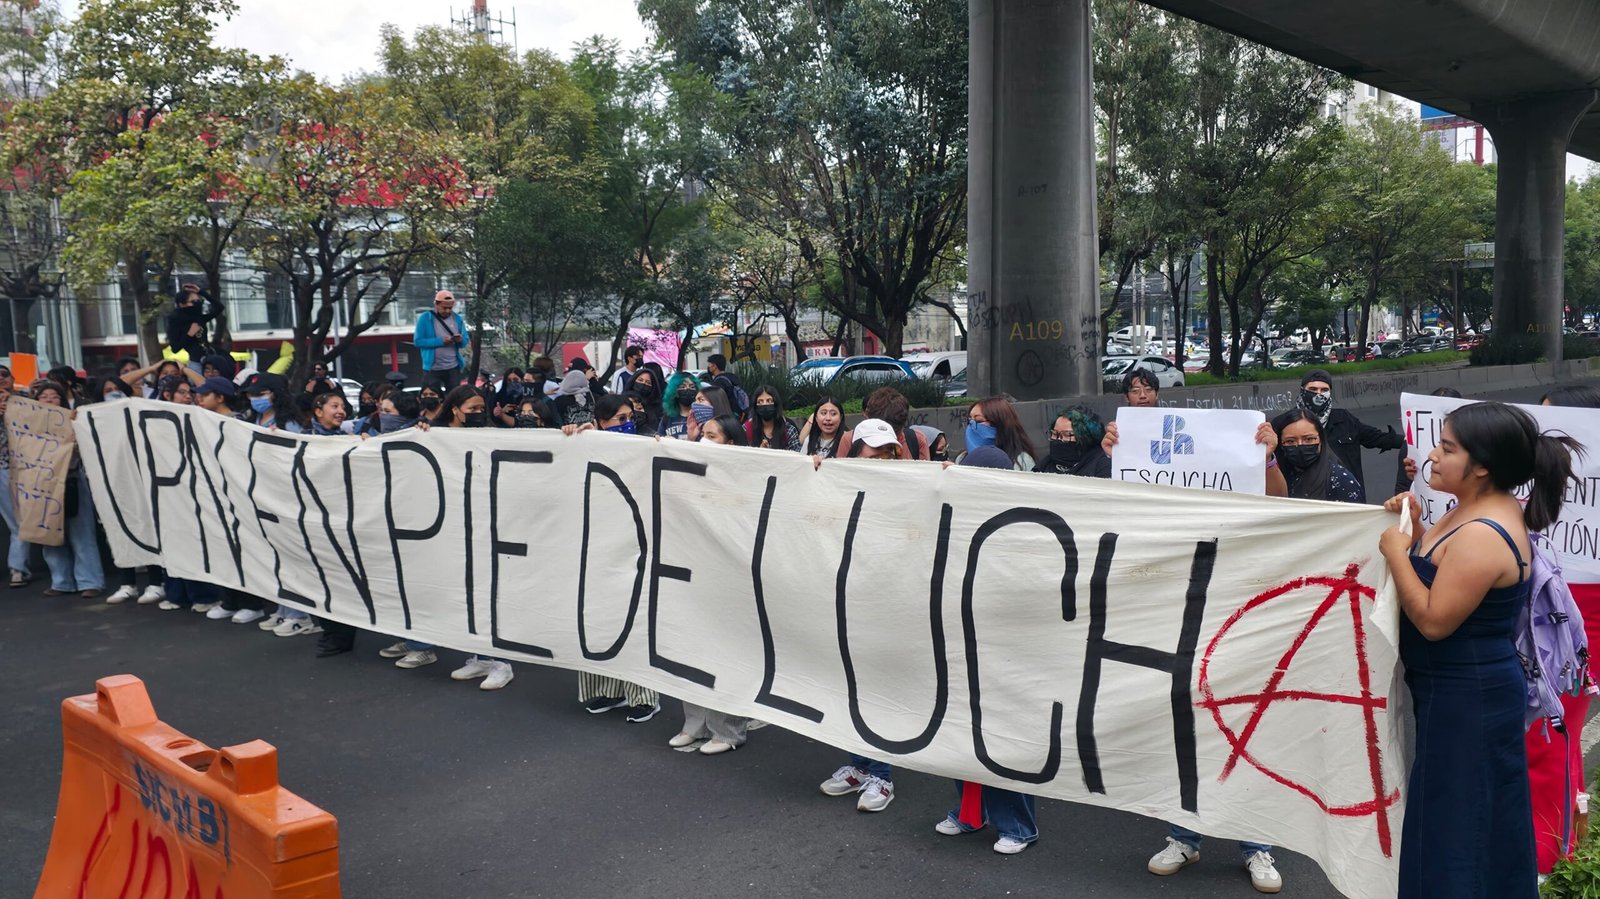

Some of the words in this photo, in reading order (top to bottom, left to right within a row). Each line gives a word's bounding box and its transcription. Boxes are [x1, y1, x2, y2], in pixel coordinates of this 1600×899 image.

[1009, 320, 1063, 341] A109
[665, 424, 684, 437] NEW
[381, 441, 553, 658] PIE
[577, 456, 717, 689] DE
[752, 475, 1400, 858] LUCHA
